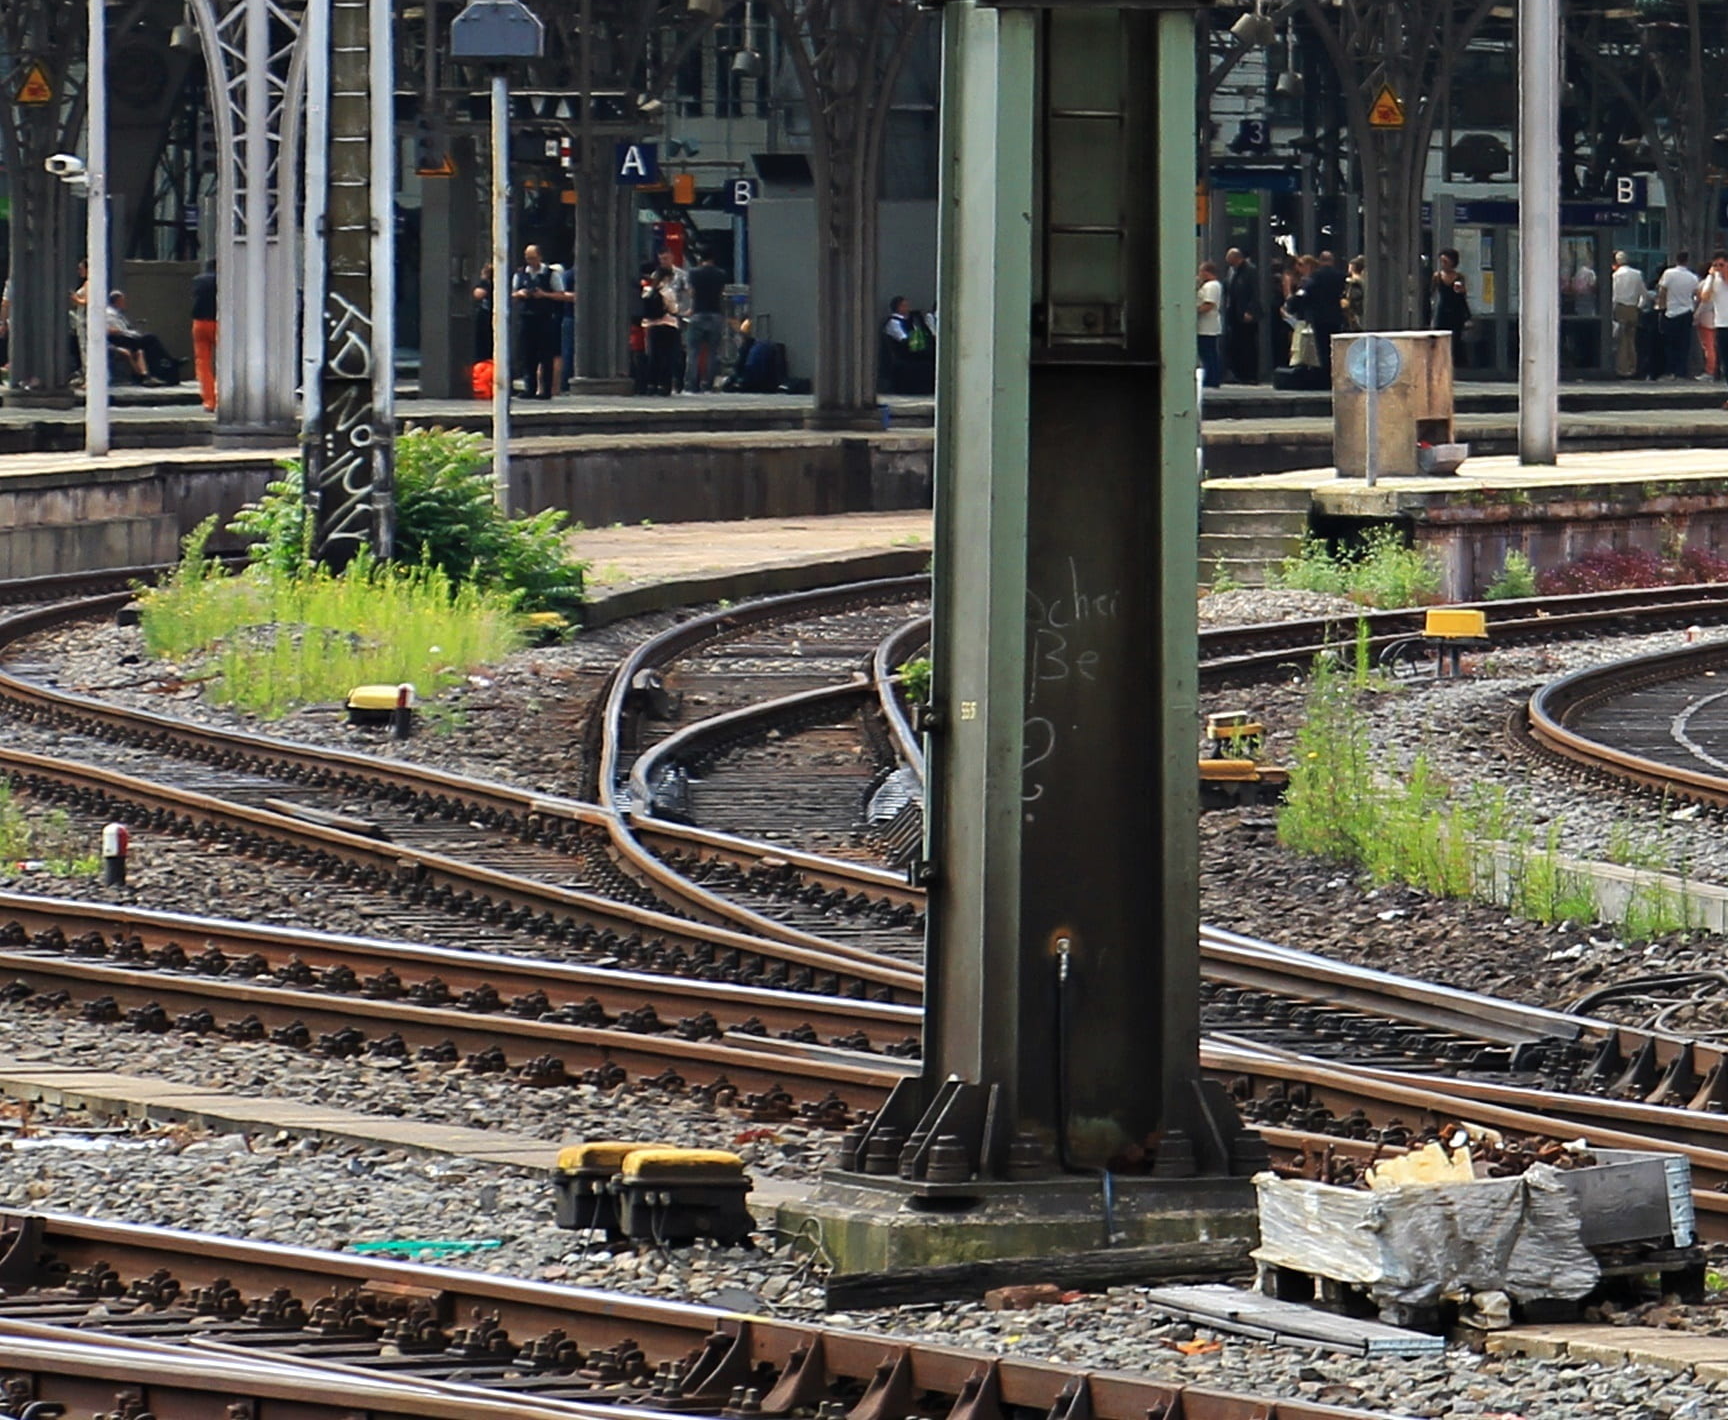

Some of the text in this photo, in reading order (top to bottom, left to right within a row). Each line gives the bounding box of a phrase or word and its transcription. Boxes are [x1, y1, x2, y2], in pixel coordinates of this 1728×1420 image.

[1250, 121, 1264, 145] 3
[620, 145, 647, 176] A
[734, 180, 750, 206] B
[1617, 177, 1634, 203] B
